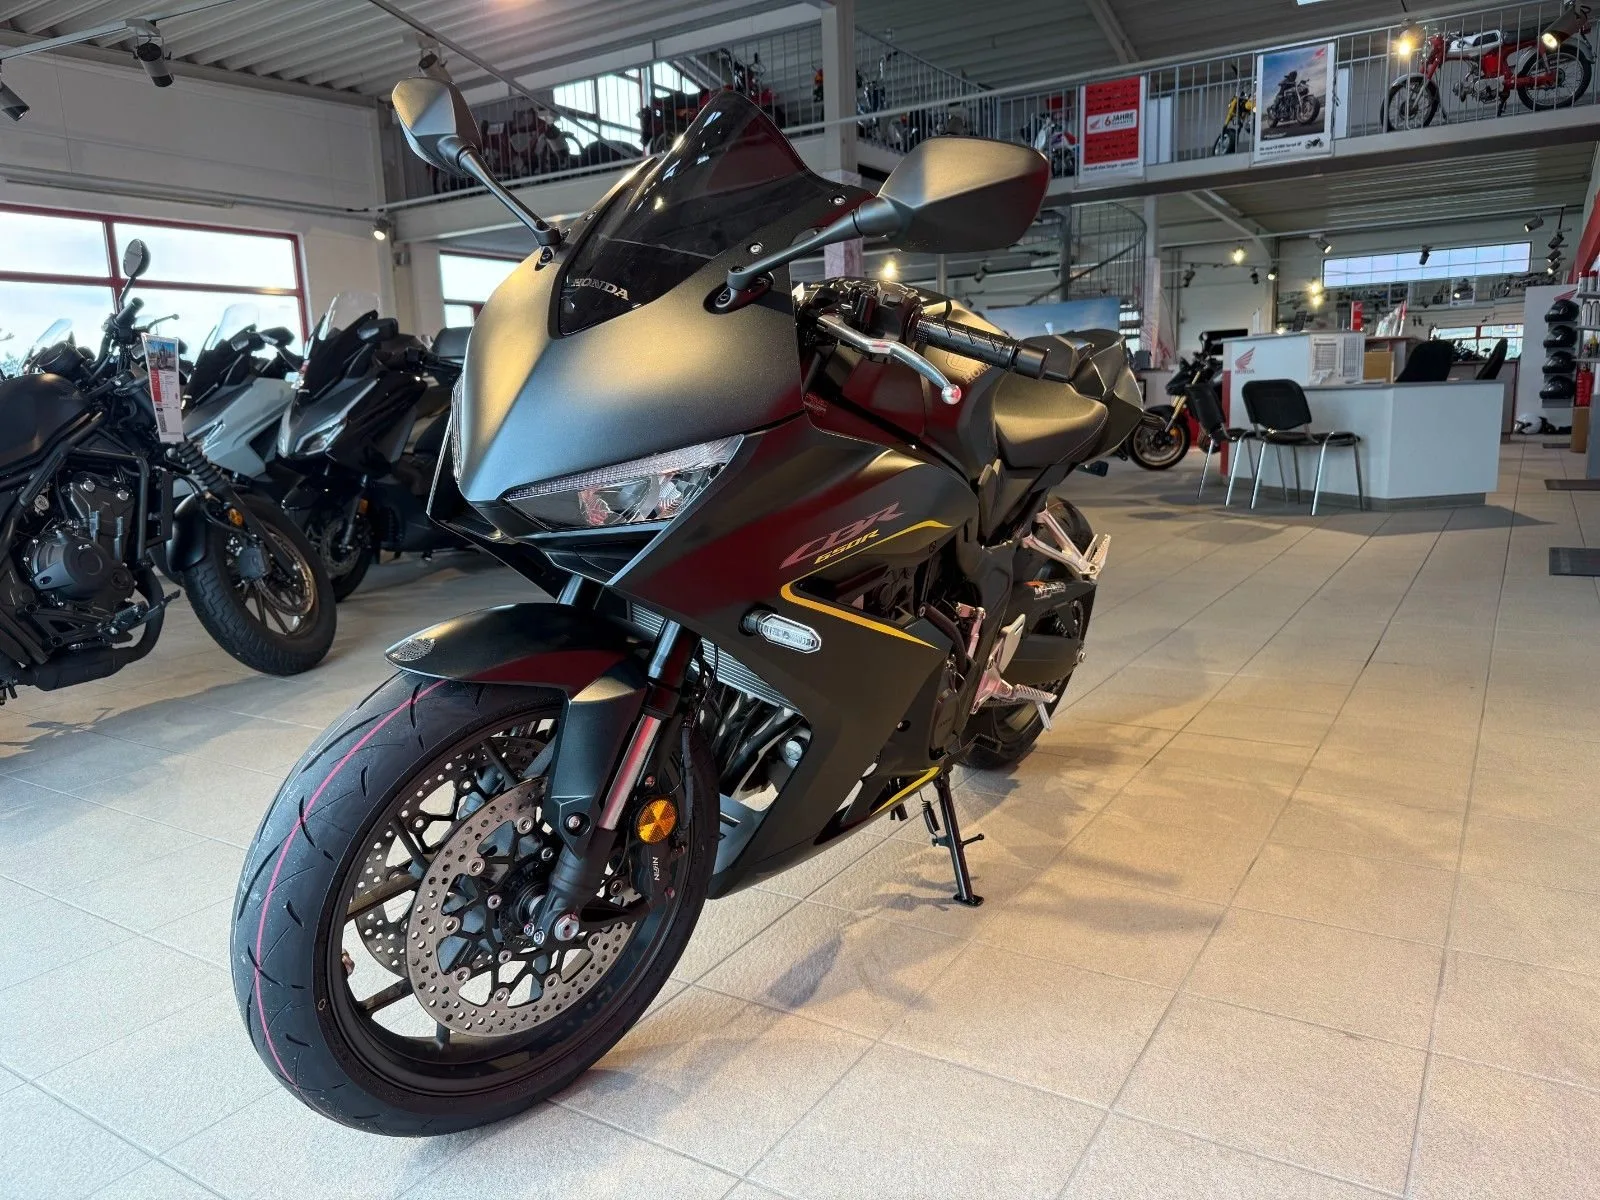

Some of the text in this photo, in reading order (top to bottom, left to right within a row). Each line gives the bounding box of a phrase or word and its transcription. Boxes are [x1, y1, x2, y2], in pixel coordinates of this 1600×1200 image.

[1104, 111, 1135, 127] 6 JAHRE
[571, 278, 629, 301] HONDA
[960, 363, 993, 385] HON
[779, 502, 907, 570] CBR
[813, 528, 880, 565] 650R
[652, 856, 660, 880] NISSIN
